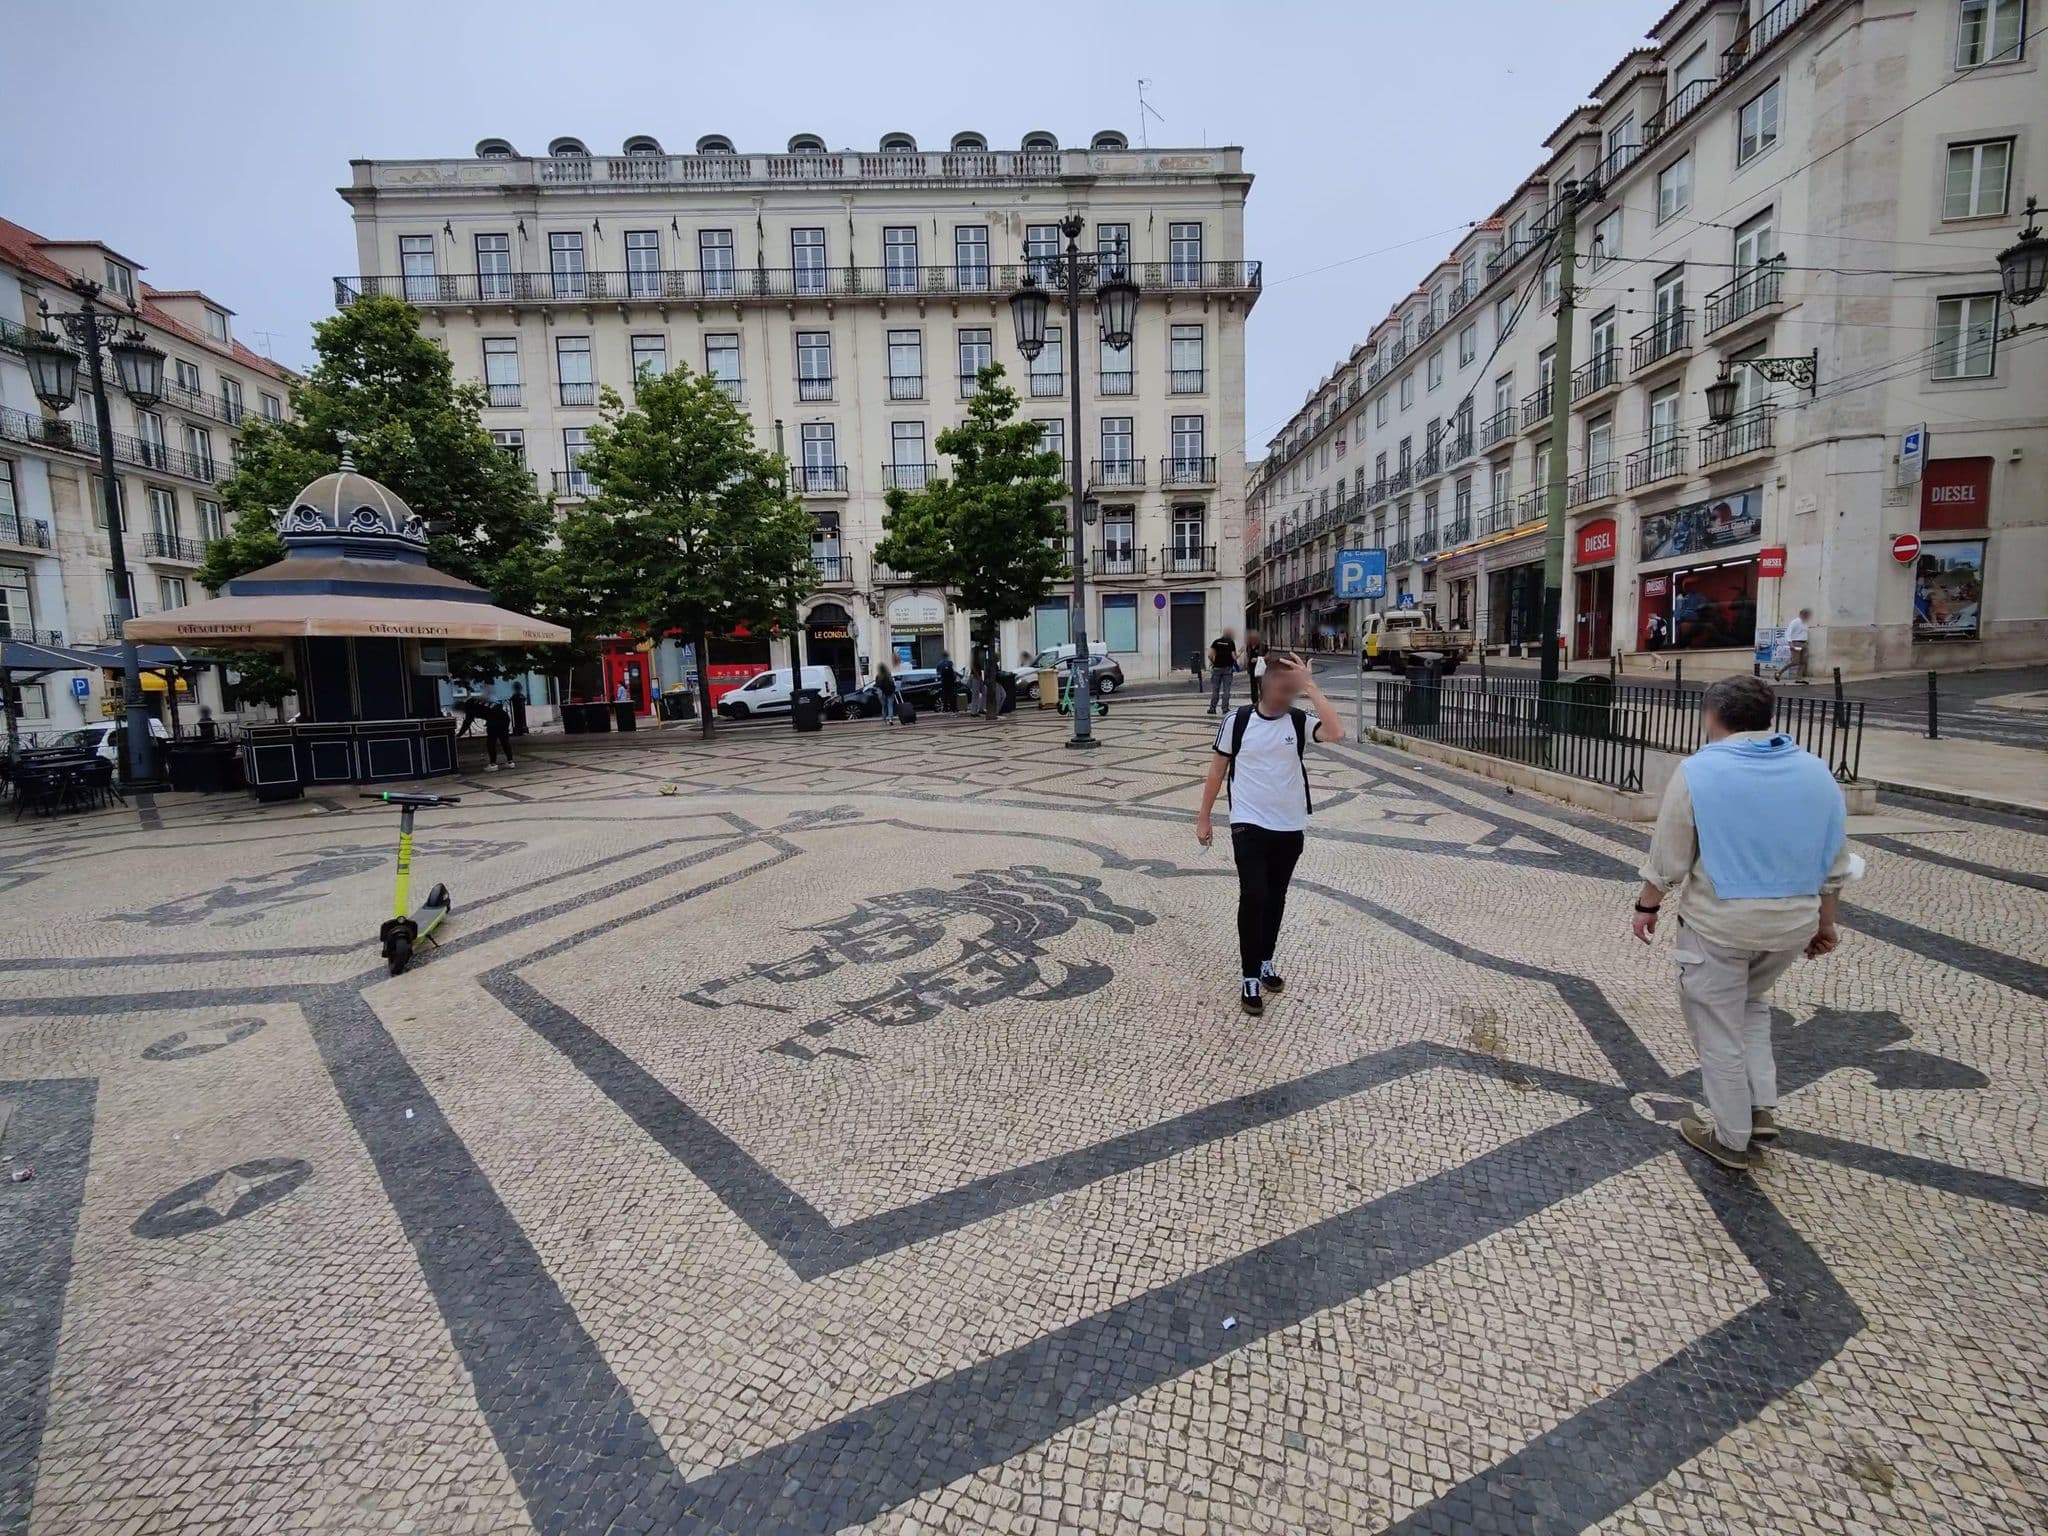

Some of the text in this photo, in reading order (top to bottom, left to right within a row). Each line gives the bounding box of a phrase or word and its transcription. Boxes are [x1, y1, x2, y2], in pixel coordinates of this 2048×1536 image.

[1931, 485, 1976, 503] DIESEL
[1585, 532, 1611, 553] DIESEL
[1762, 558, 1782, 567] DIESEL
[1342, 563, 1363, 593] P
[1646, 580, 1665, 593] DIESEL
[76, 680, 86, 693] P
